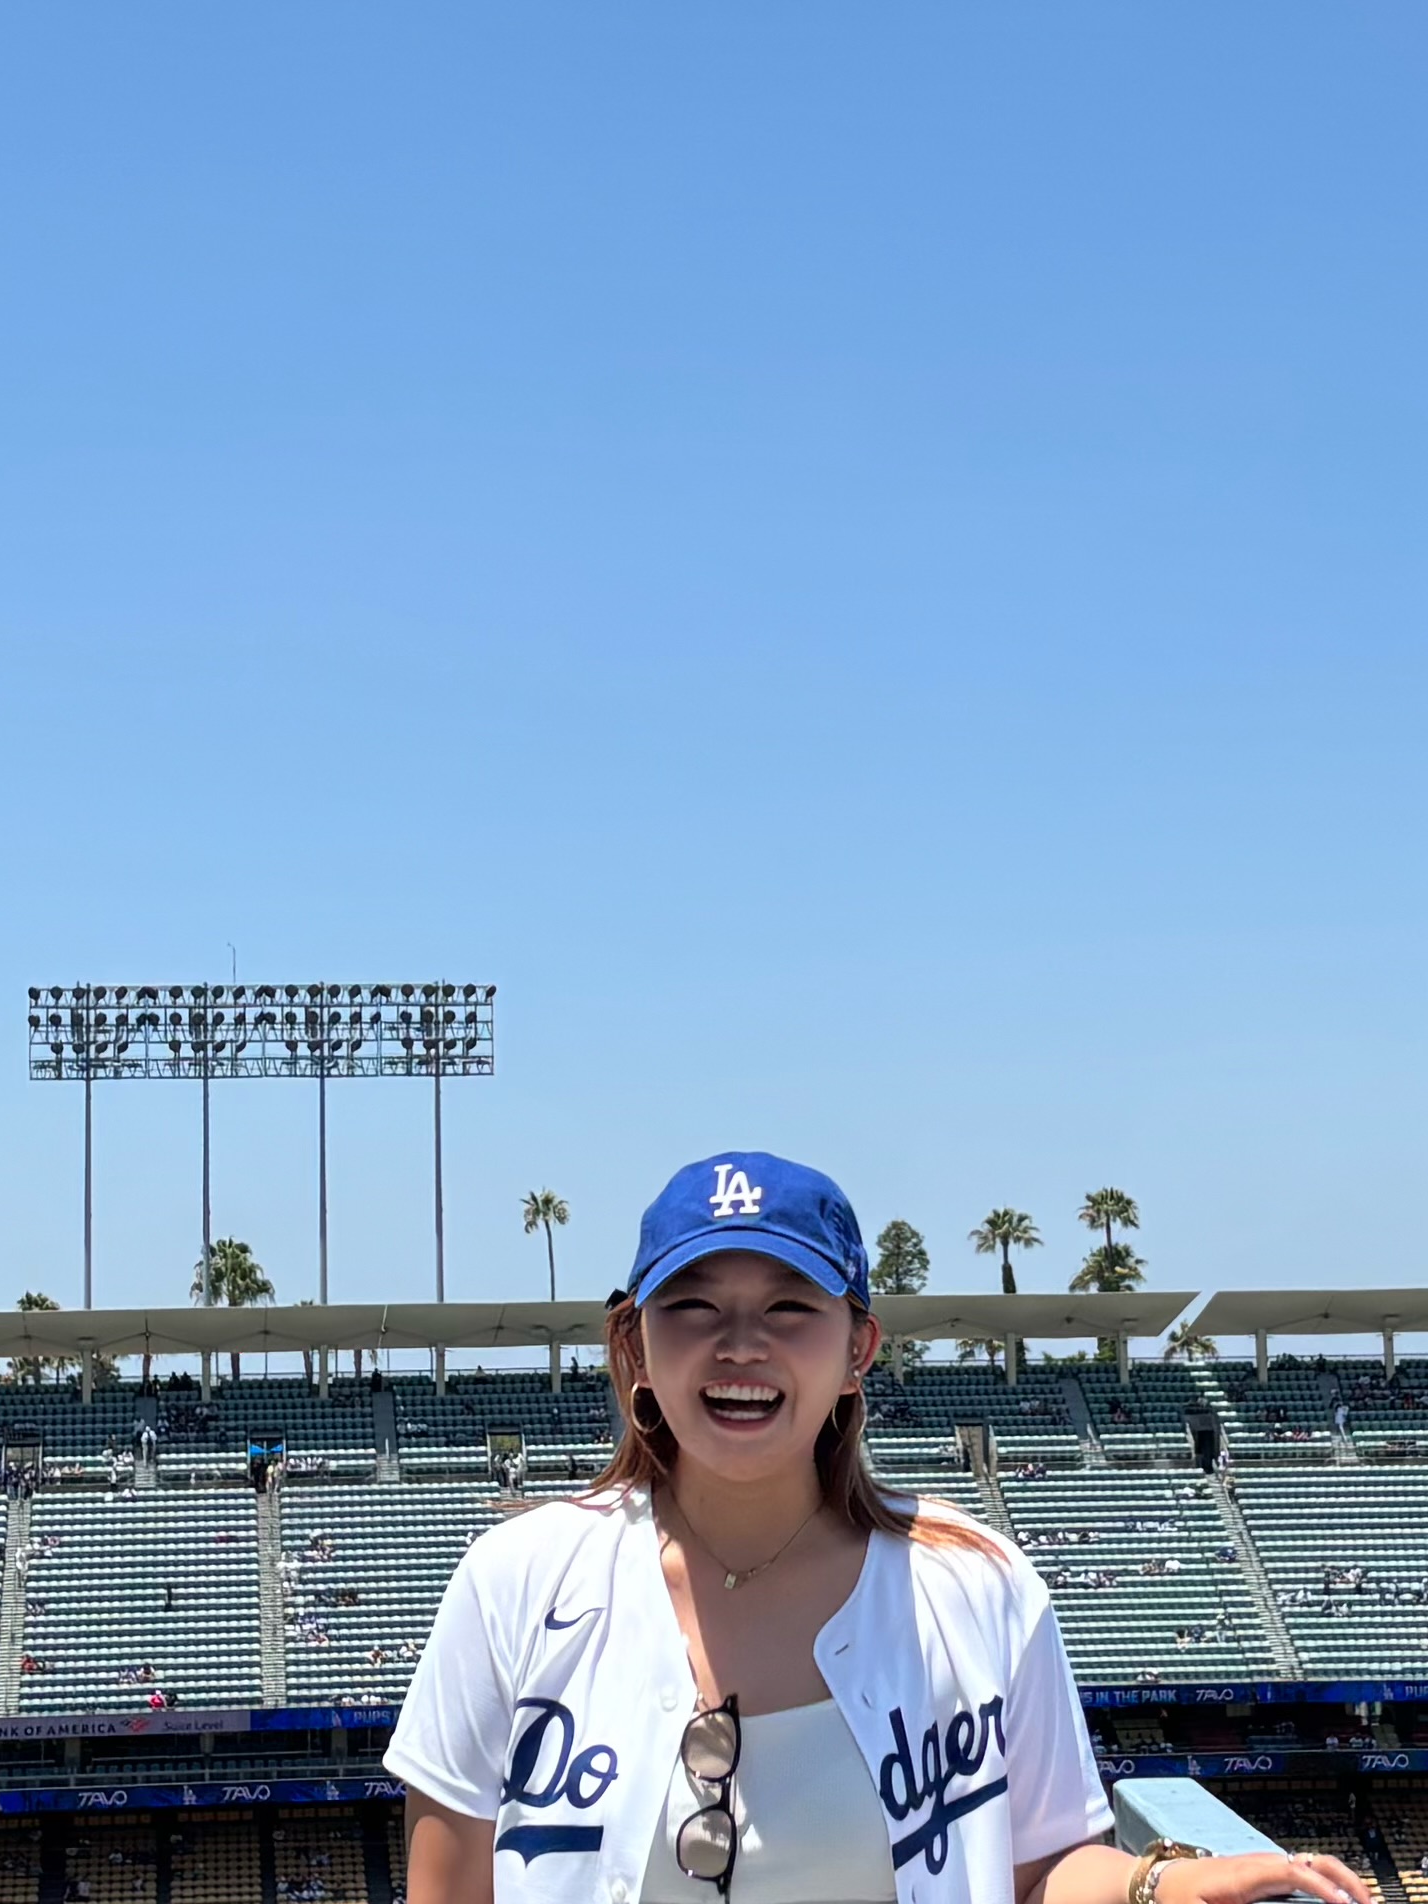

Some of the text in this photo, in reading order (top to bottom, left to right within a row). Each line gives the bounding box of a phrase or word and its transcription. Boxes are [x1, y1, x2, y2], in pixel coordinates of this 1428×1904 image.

[709, 1163, 762, 1217] LA
[1095, 1691, 1109, 1703] IN
[1113, 1690, 1140, 1704] THE
[1142, 1689, 1177, 1703] PARK
[1195, 1688, 1234, 1701] TAVO
[24, 1724, 41, 1737] OF
[45, 1722, 117, 1736] AMERICA
[500, 1697, 619, 1809] Do
[1362, 1753, 1409, 1769] TAVO
[1097, 1759, 1135, 1774] AVO
[1224, 1755, 1272, 1772] TAVO
[79, 1791, 128, 1808] TAVO
[222, 1784, 271, 1801] TAVO
